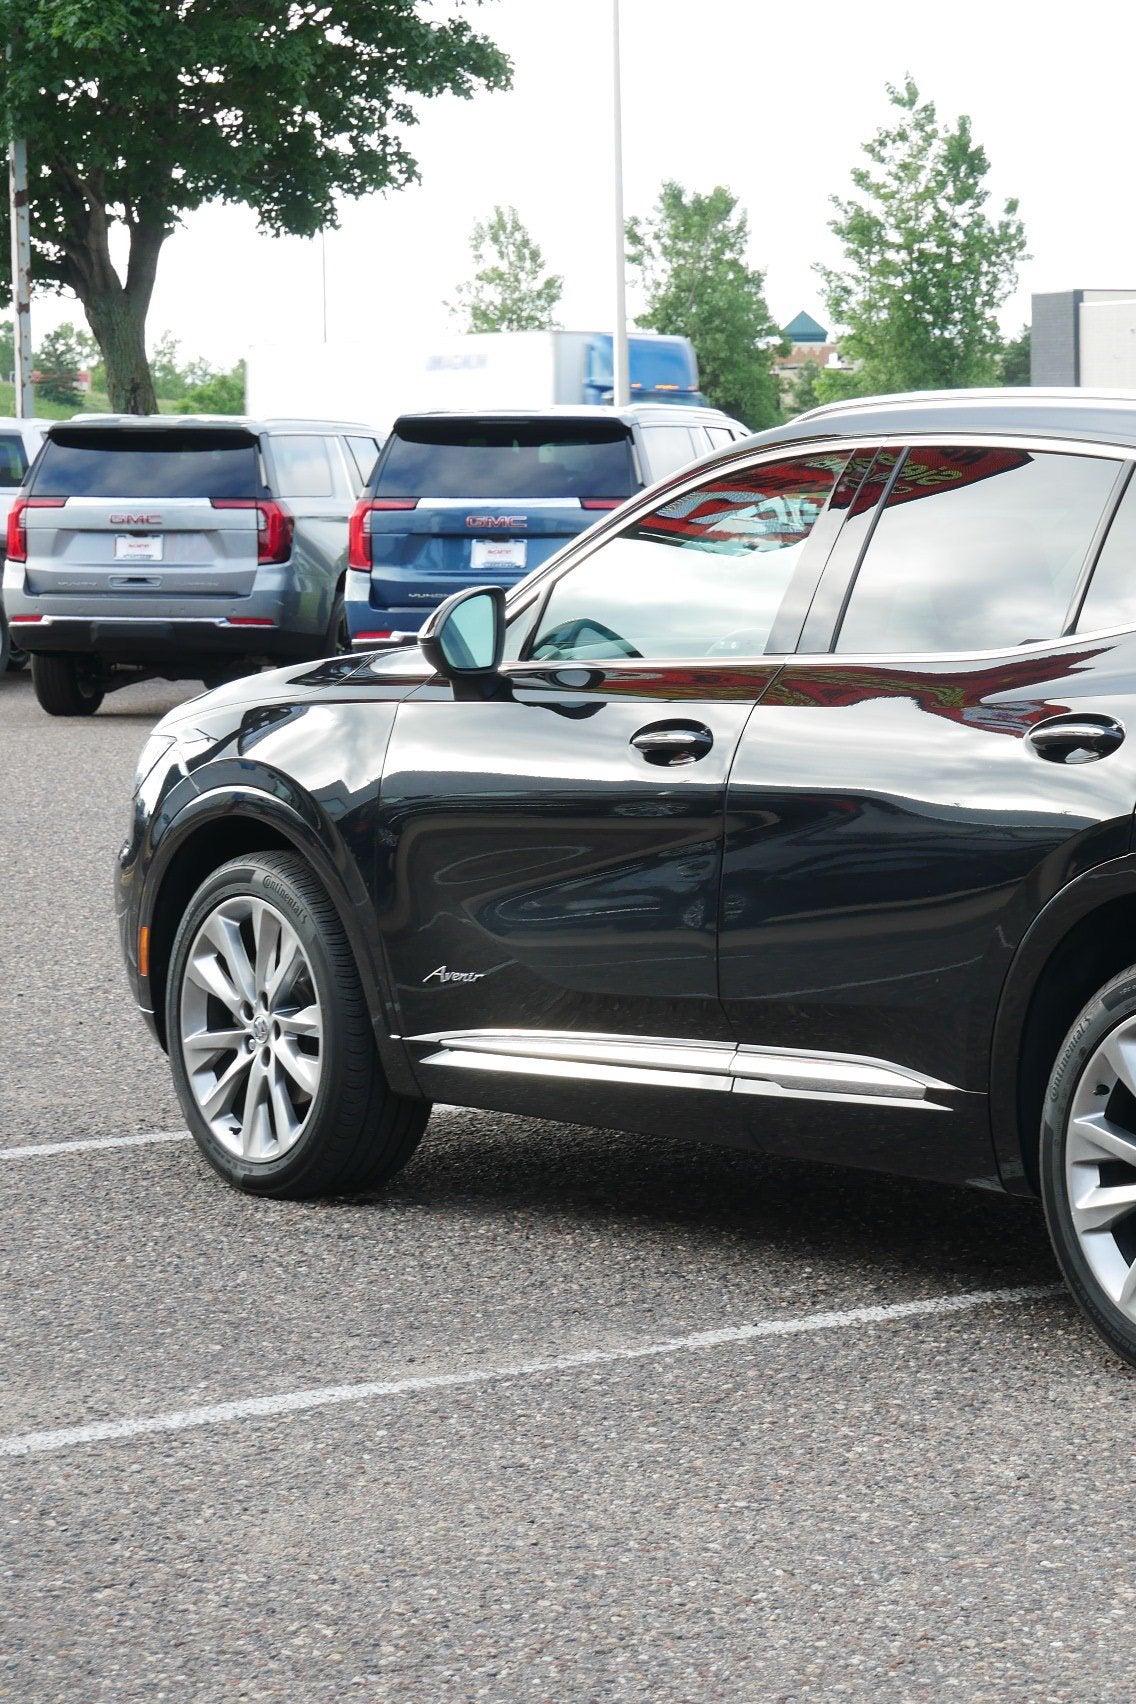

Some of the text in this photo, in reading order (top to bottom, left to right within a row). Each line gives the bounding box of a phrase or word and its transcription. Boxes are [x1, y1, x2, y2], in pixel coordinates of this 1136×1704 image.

[109, 514, 162, 525] GMC
[466, 515, 528, 528] GMC
[422, 965, 487, 983] Avenir
